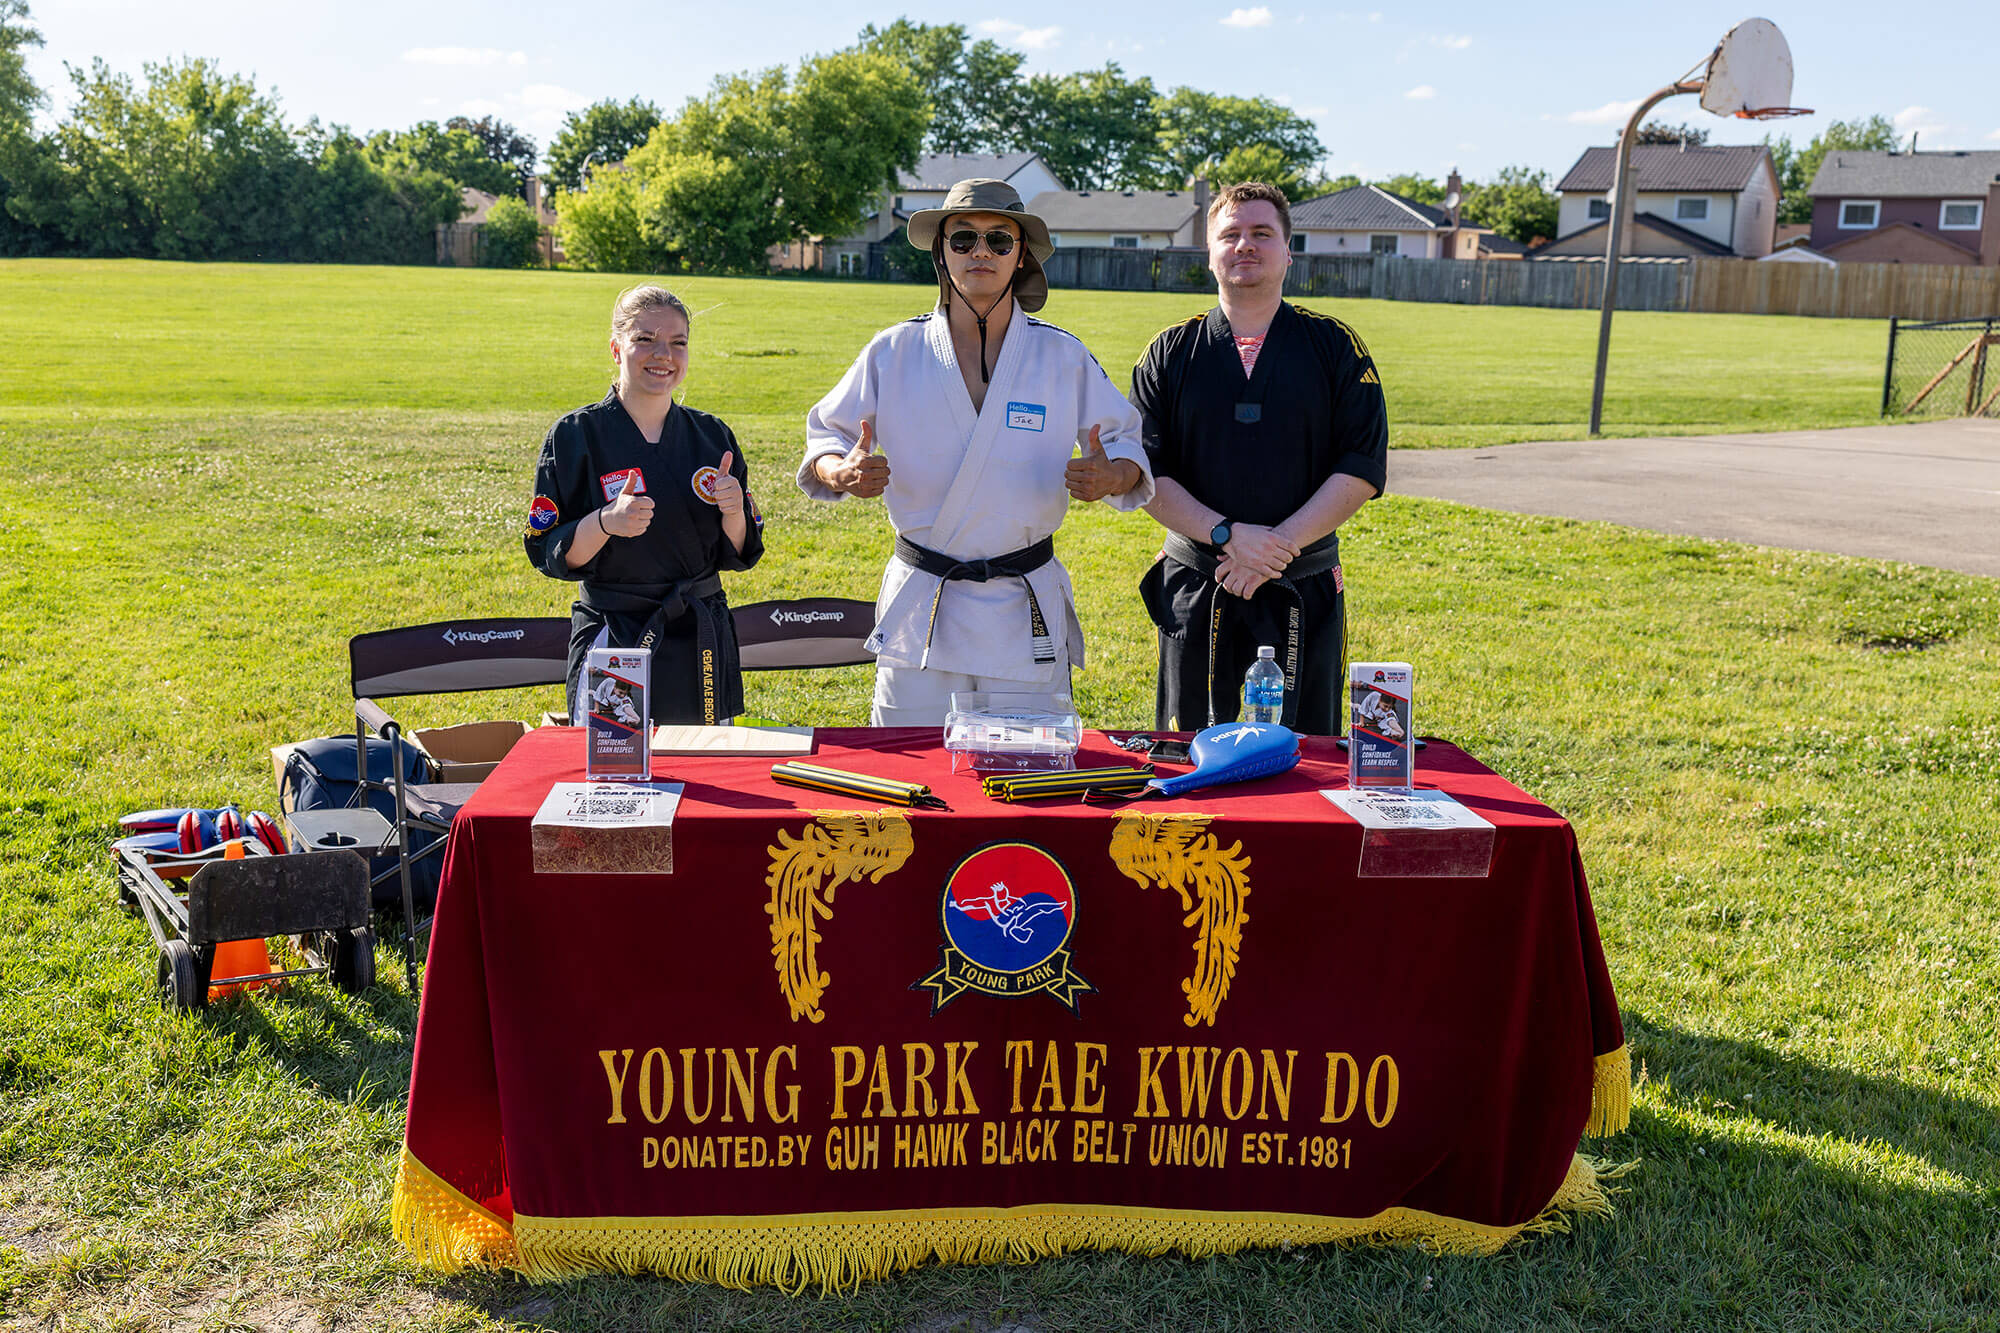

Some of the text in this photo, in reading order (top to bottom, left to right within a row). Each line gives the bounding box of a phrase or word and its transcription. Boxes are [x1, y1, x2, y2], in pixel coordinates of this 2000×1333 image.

[602, 474, 622, 485] Hello
[784, 610, 845, 623] KingCamp
[458, 629, 525, 643] KingCamp
[958, 961, 1056, 990] YOUNG PARK
[598, 1039, 1400, 1129] YOUNG PARK TAE KWON DO
[643, 1118, 1352, 1171] DONATED.BY GUH HAWK BLACK BELT UNION EST.1981
